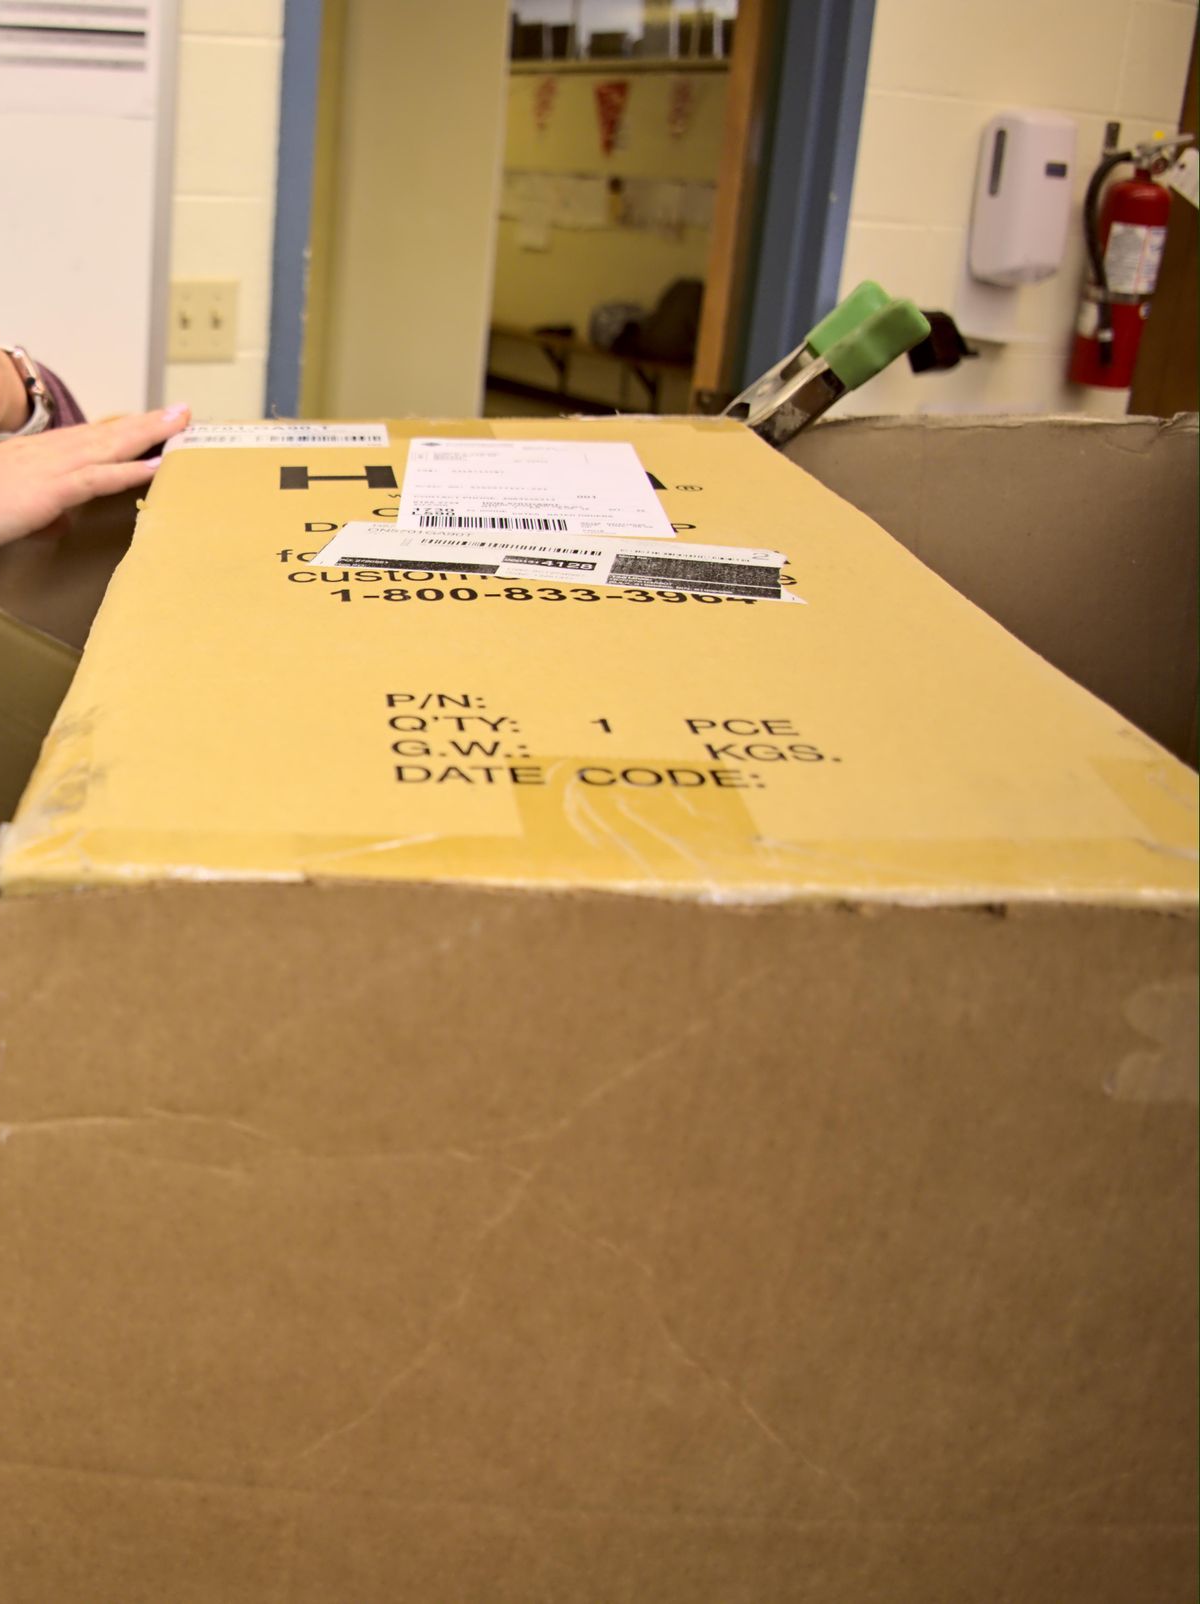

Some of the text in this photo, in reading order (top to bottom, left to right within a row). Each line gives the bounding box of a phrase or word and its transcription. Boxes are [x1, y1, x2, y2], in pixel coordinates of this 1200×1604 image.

[385, 693, 487, 709] P/N:
[388, 716, 800, 736] Q'TY: 1 PCE
[390, 740, 843, 763] G.W.: KGS.
[394, 765, 767, 789] DATE CODE:
